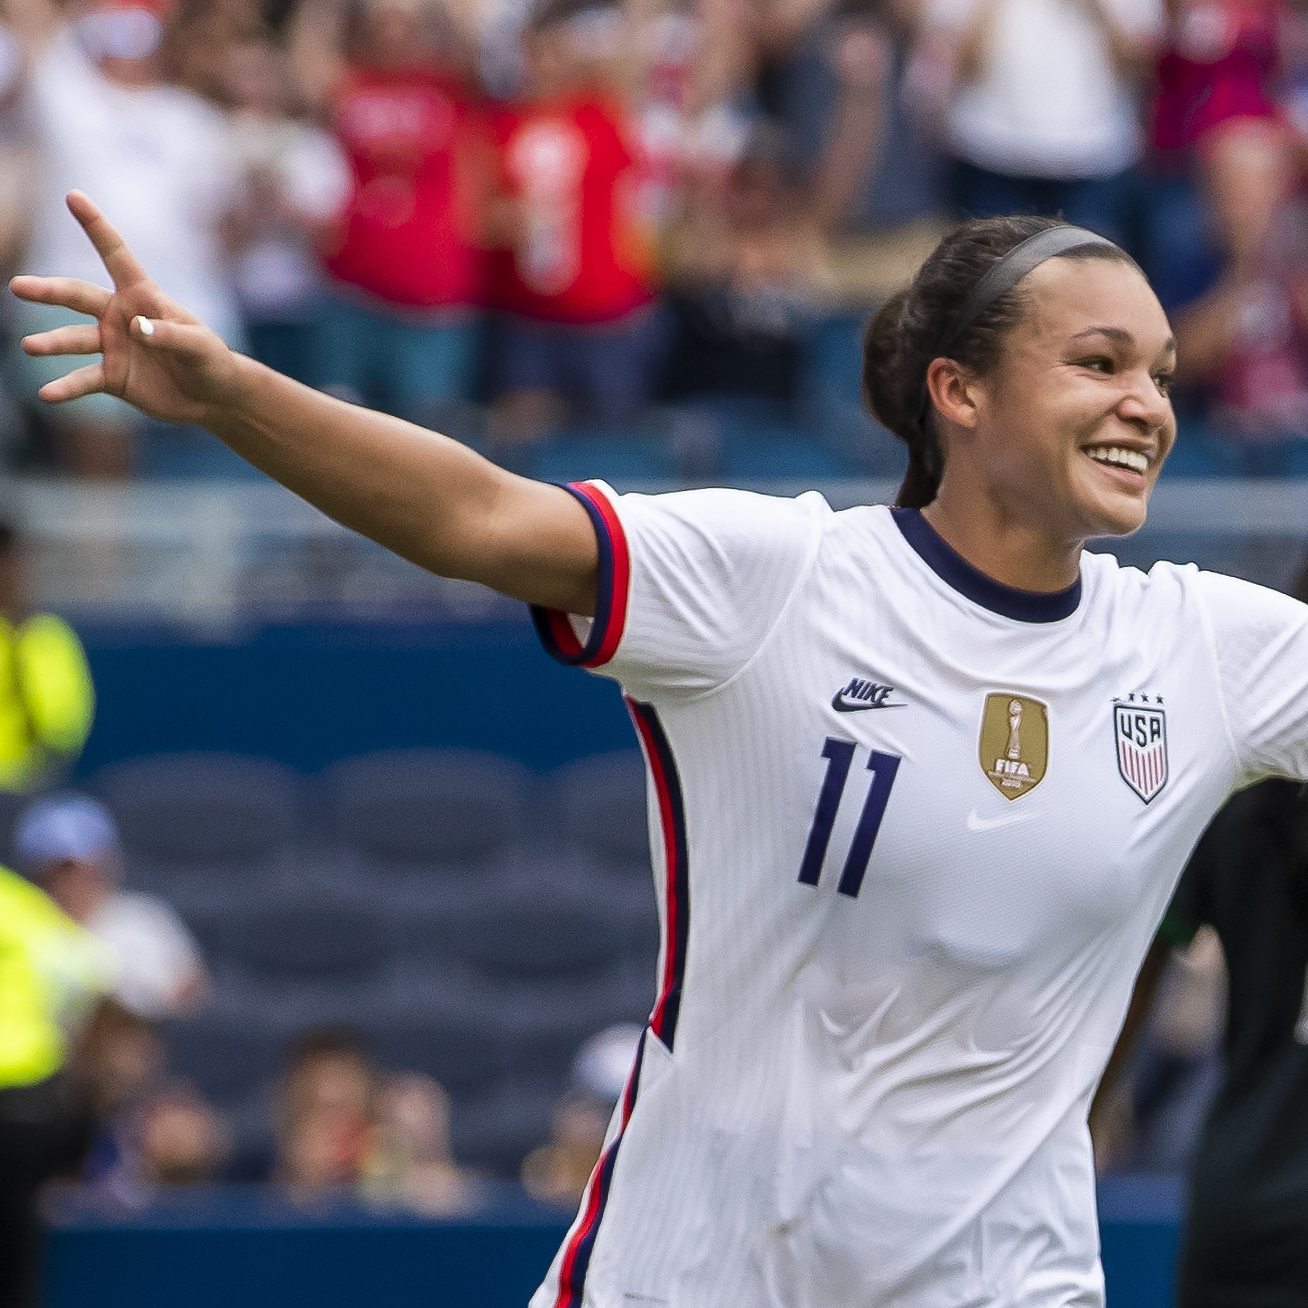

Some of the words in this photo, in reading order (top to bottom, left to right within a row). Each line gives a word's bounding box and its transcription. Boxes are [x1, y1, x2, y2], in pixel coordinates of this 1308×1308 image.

[842, 677, 894, 706] NIKE
[1120, 713, 1161, 748] USA
[995, 758, 1030, 778] FIFA
[797, 736, 903, 899] 11
